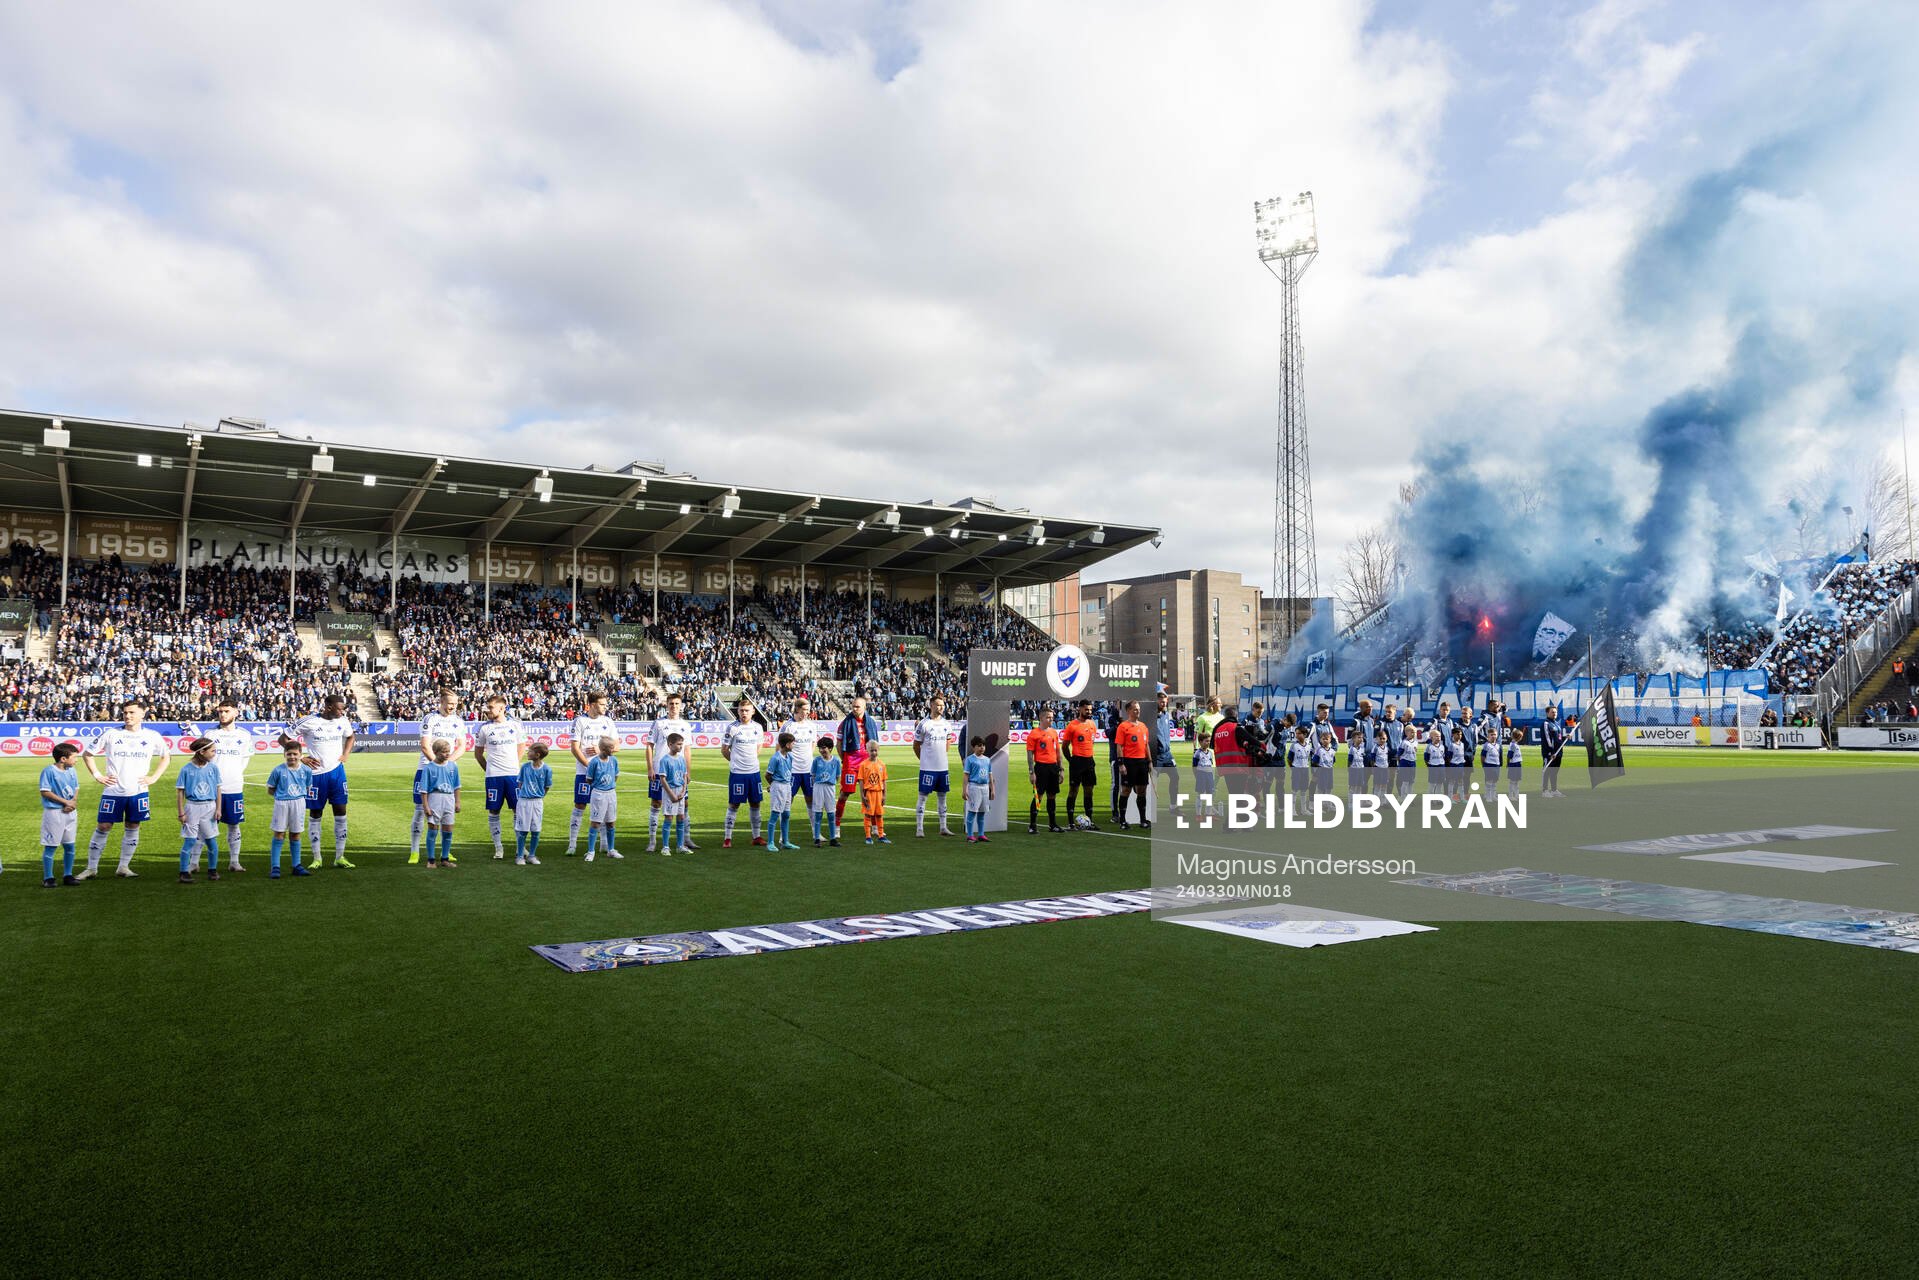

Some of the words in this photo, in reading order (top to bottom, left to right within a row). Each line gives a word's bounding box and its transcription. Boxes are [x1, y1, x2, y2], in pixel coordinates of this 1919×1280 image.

[86, 533, 168, 559] 1956
[475, 558, 536, 579] 1957
[631, 567, 688, 589] 1962
[327, 623, 363, 631] HOLMEN
[606, 632, 635, 640] HOLMEN
[981, 661, 1037, 677] UNIBET
[1099, 664, 1149, 680] UNIBET
[19, 726, 63, 737] EASY
[79, 726, 110, 737] CO
[1215, 730, 1230, 738] FOTO
[1644, 728, 1691, 740] weber
[1743, 730, 1762, 743] DS
[1764, 730, 1805, 743] mith
